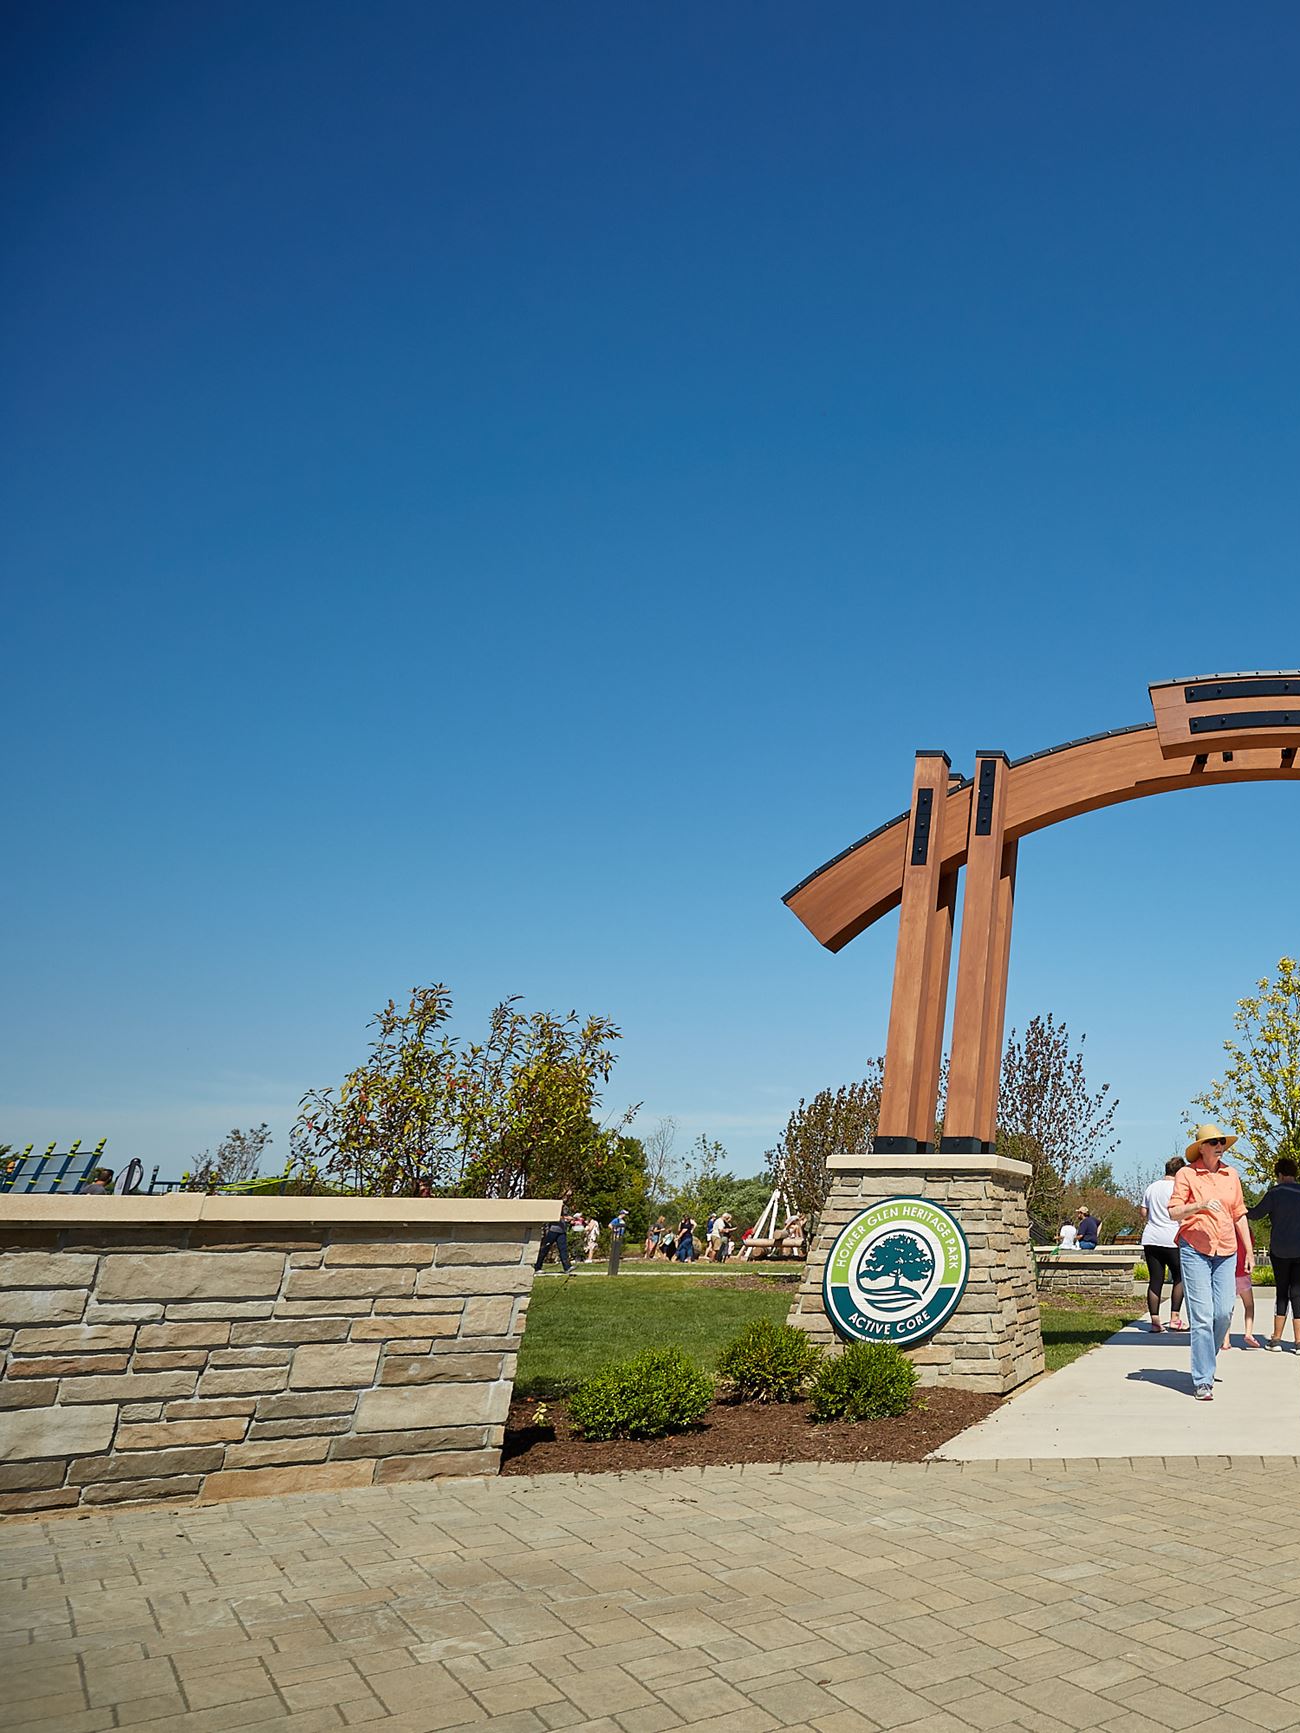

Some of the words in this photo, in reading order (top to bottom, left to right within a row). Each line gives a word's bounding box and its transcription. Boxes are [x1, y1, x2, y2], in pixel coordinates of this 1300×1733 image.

[837, 1226, 867, 1268] HOMER
[867, 1207, 899, 1227] GLEN
[902, 1206, 951, 1238] HERITAGE
[945, 1239, 959, 1270] PARK
[848, 1312, 891, 1335] ACTIVE
[896, 1310, 931, 1334] CORE
